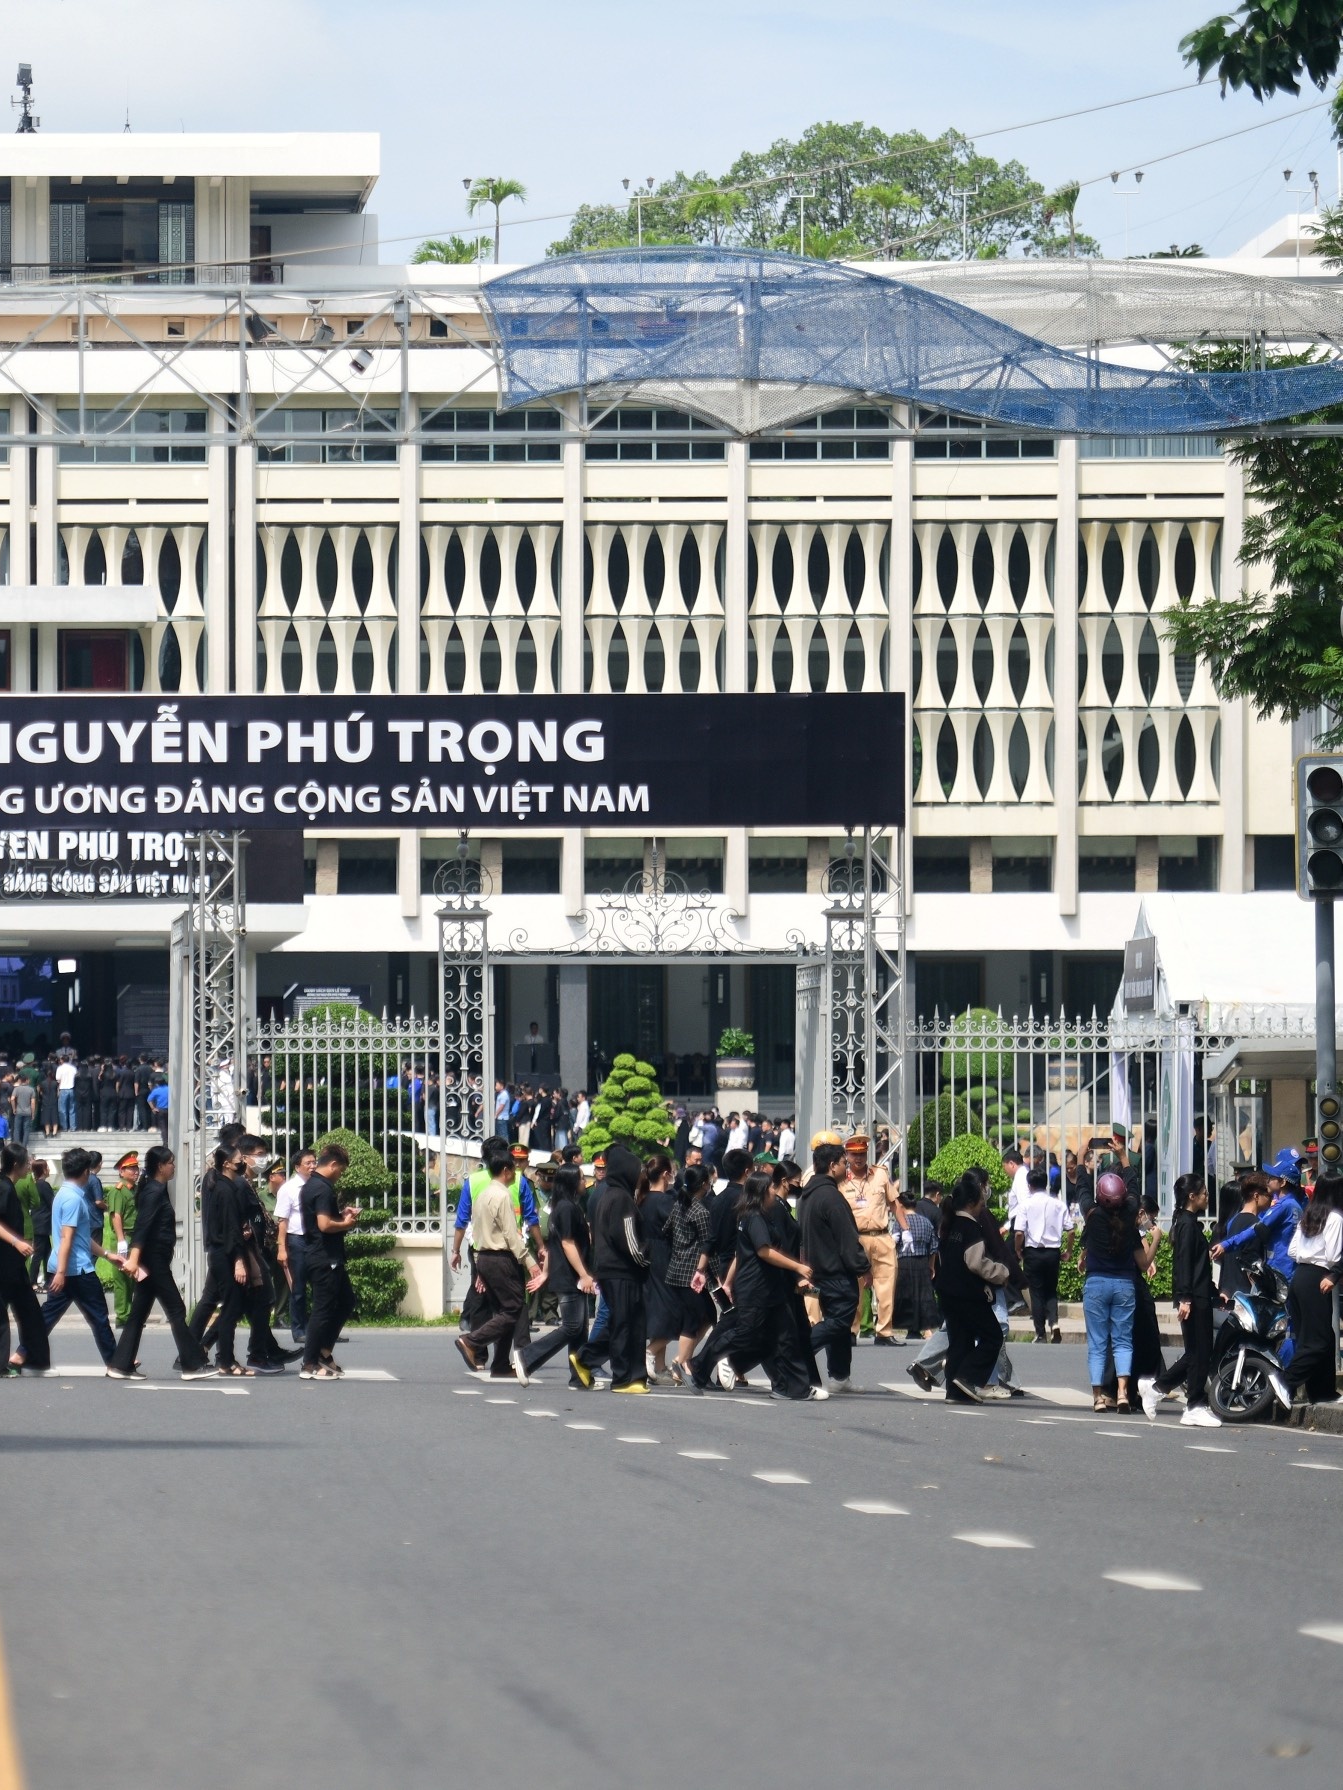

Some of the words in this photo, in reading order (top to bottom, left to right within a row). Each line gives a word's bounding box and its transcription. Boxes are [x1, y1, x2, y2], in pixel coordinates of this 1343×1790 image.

[247, 711, 374, 763] PHÚ
[388, 720, 605, 776] TRỌNG
[34, 783, 147, 814] ƯƠNG
[154, 779, 265, 814] ĐẢNG
[273, 780, 381, 821] CỘNG
[390, 776, 465, 814] SẢN
[472, 780, 554, 821] VIỆT
[563, 785, 650, 812] NAM
